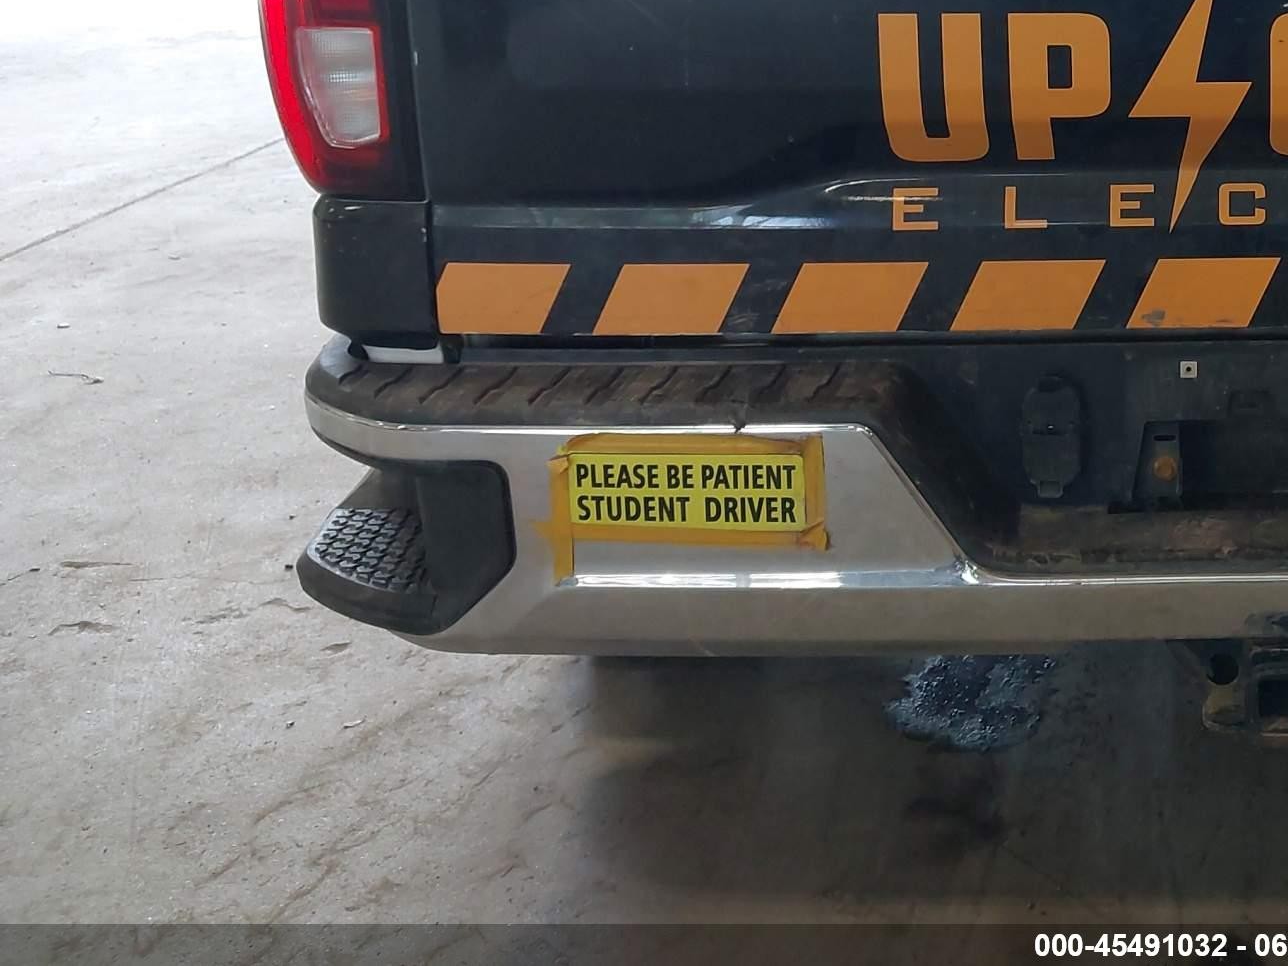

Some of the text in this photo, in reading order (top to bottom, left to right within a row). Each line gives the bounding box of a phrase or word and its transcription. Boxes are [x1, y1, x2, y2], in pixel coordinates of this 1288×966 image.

[576, 464, 797, 490] PLEASE BE PATIENT
[577, 495, 797, 523] STUDENT DRIVER
